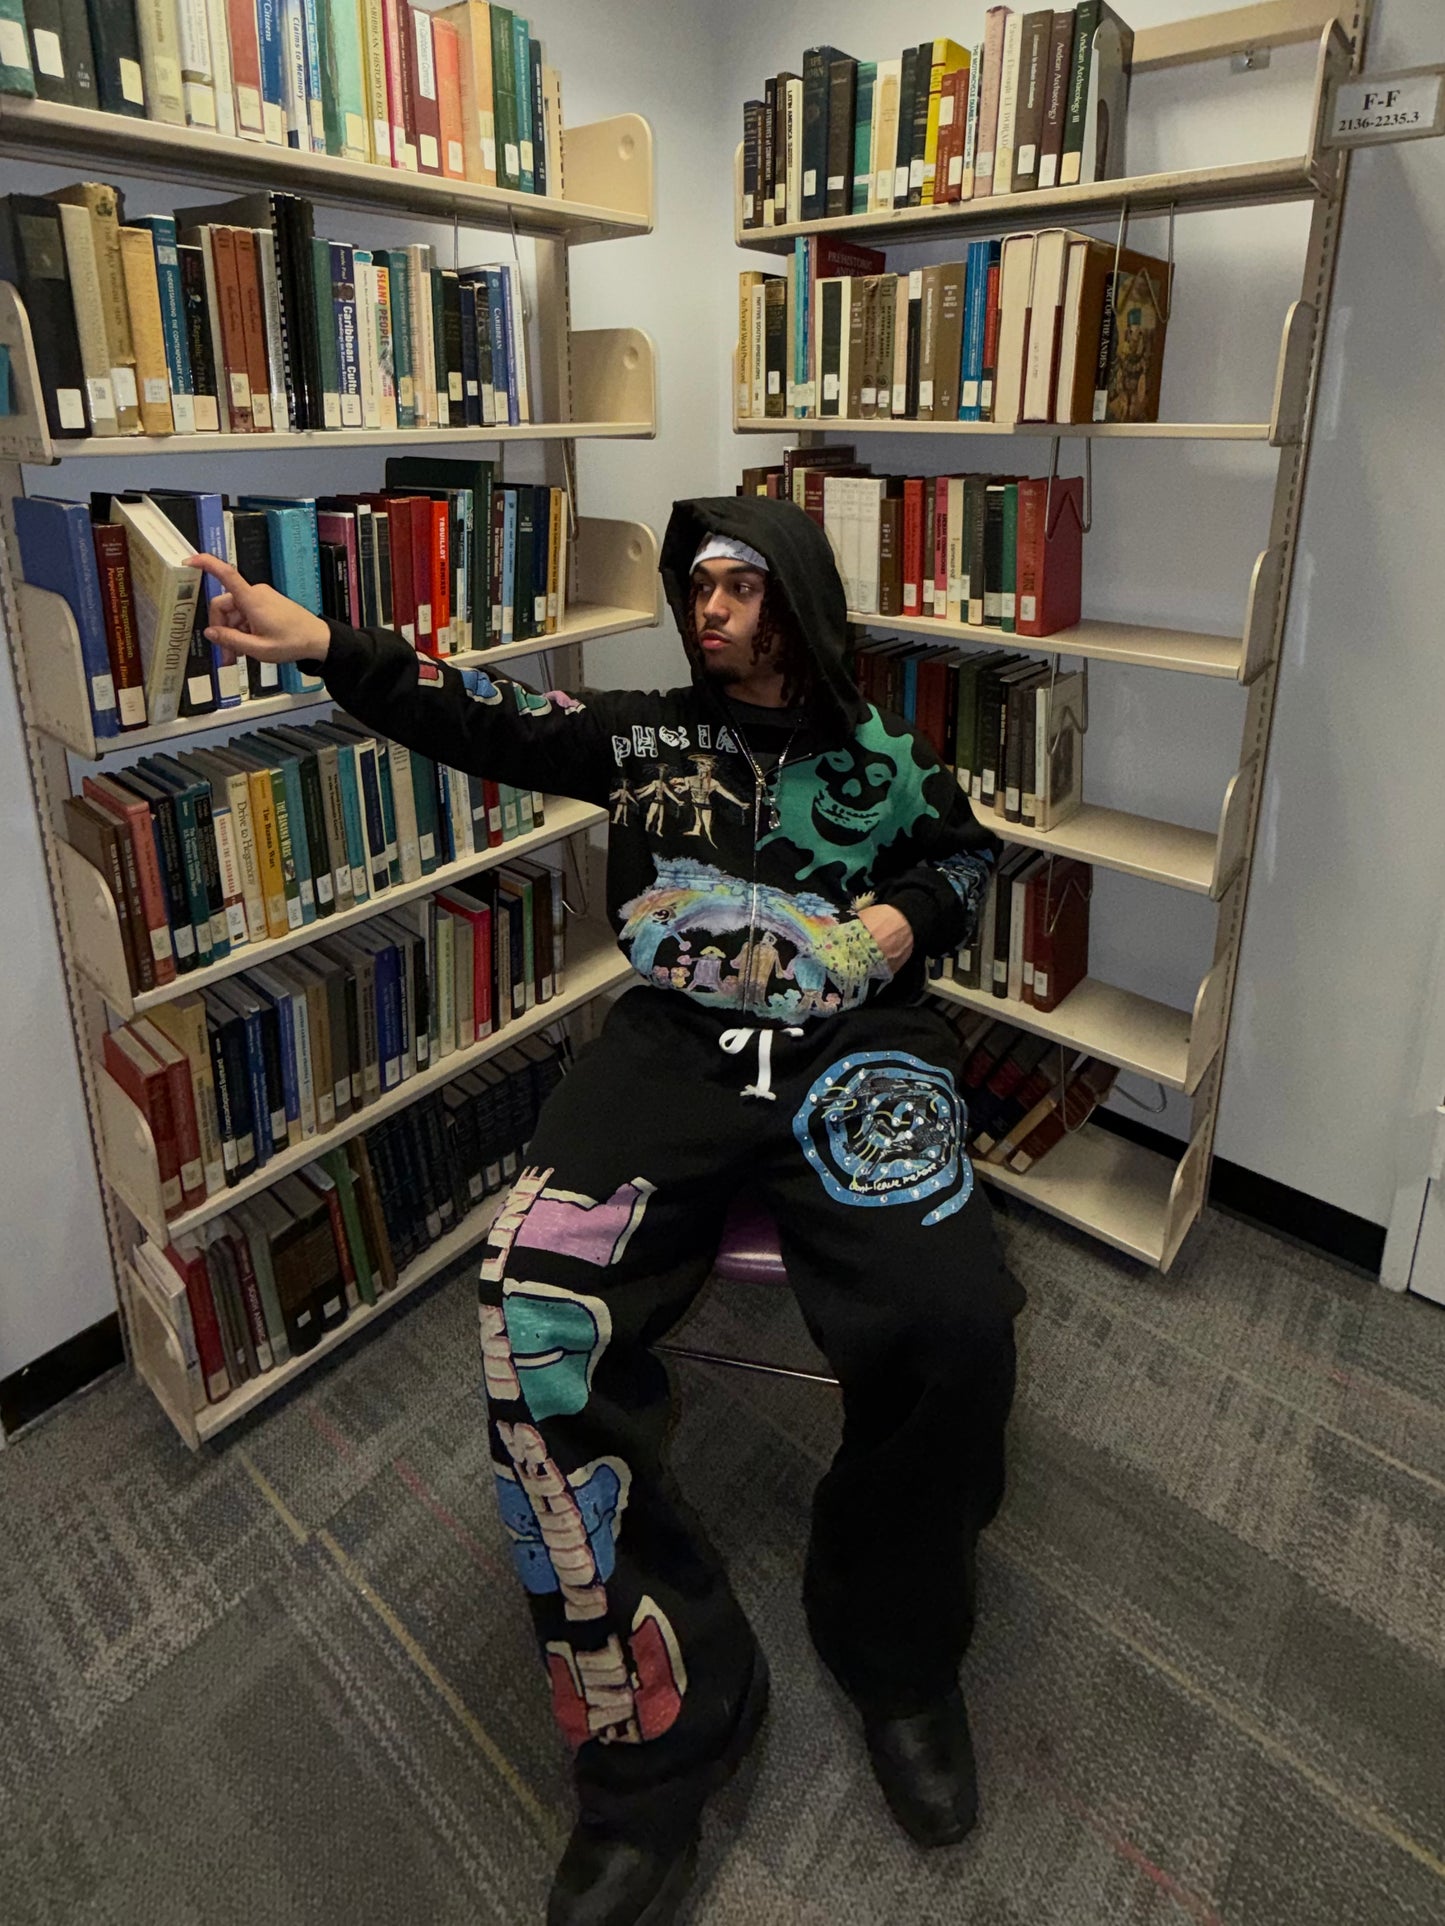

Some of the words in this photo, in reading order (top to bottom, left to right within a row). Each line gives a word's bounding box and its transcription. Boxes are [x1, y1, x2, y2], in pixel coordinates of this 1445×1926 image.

[295, 51, 301, 60] to
[1055, 42, 1064, 70] Andean
[1077, 32, 1088, 63] Andean
[373, 52, 382, 89] HISTORY
[969, 58, 978, 97] MOTORCYCLE
[1048, 73, 1061, 120] Archaeology
[1071, 65, 1085, 113] Archaeology
[1362, 89, 1400, 111] F-F
[1338, 111, 1420, 132] 2136-2235.3
[828, 251, 873, 270] PREHISTORIC
[377, 269, 388, 305] ISLAND
[1106, 285, 1114, 303] ART
[166, 271, 177, 317] UNDERSTANDING
[173, 331, 182, 374] CONTEMPORARY
[1105, 305, 1111, 316] OF
[343, 306, 355, 362] Caribbean
[378, 308, 389, 346] PEOPLE
[494, 308, 502, 350] CARIBBEAN
[1102, 319, 1110, 336] THE
[1099, 338, 1109, 368] ANDES
[107, 568, 119, 613] Perspectives
[116, 567, 128, 598] Beyond
[114, 614, 121, 624] on
[120, 599, 134, 658] Fragmentation
[116, 626, 125, 664] Caribbean
[165, 601, 196, 671] Caribbean
[237, 801, 249, 827] Drive
[276, 801, 287, 814] THE
[241, 830, 249, 838] to
[265, 823, 273, 849] Banana
[278, 814, 290, 840] BANANA
[241, 839, 255, 885] Hegemony
